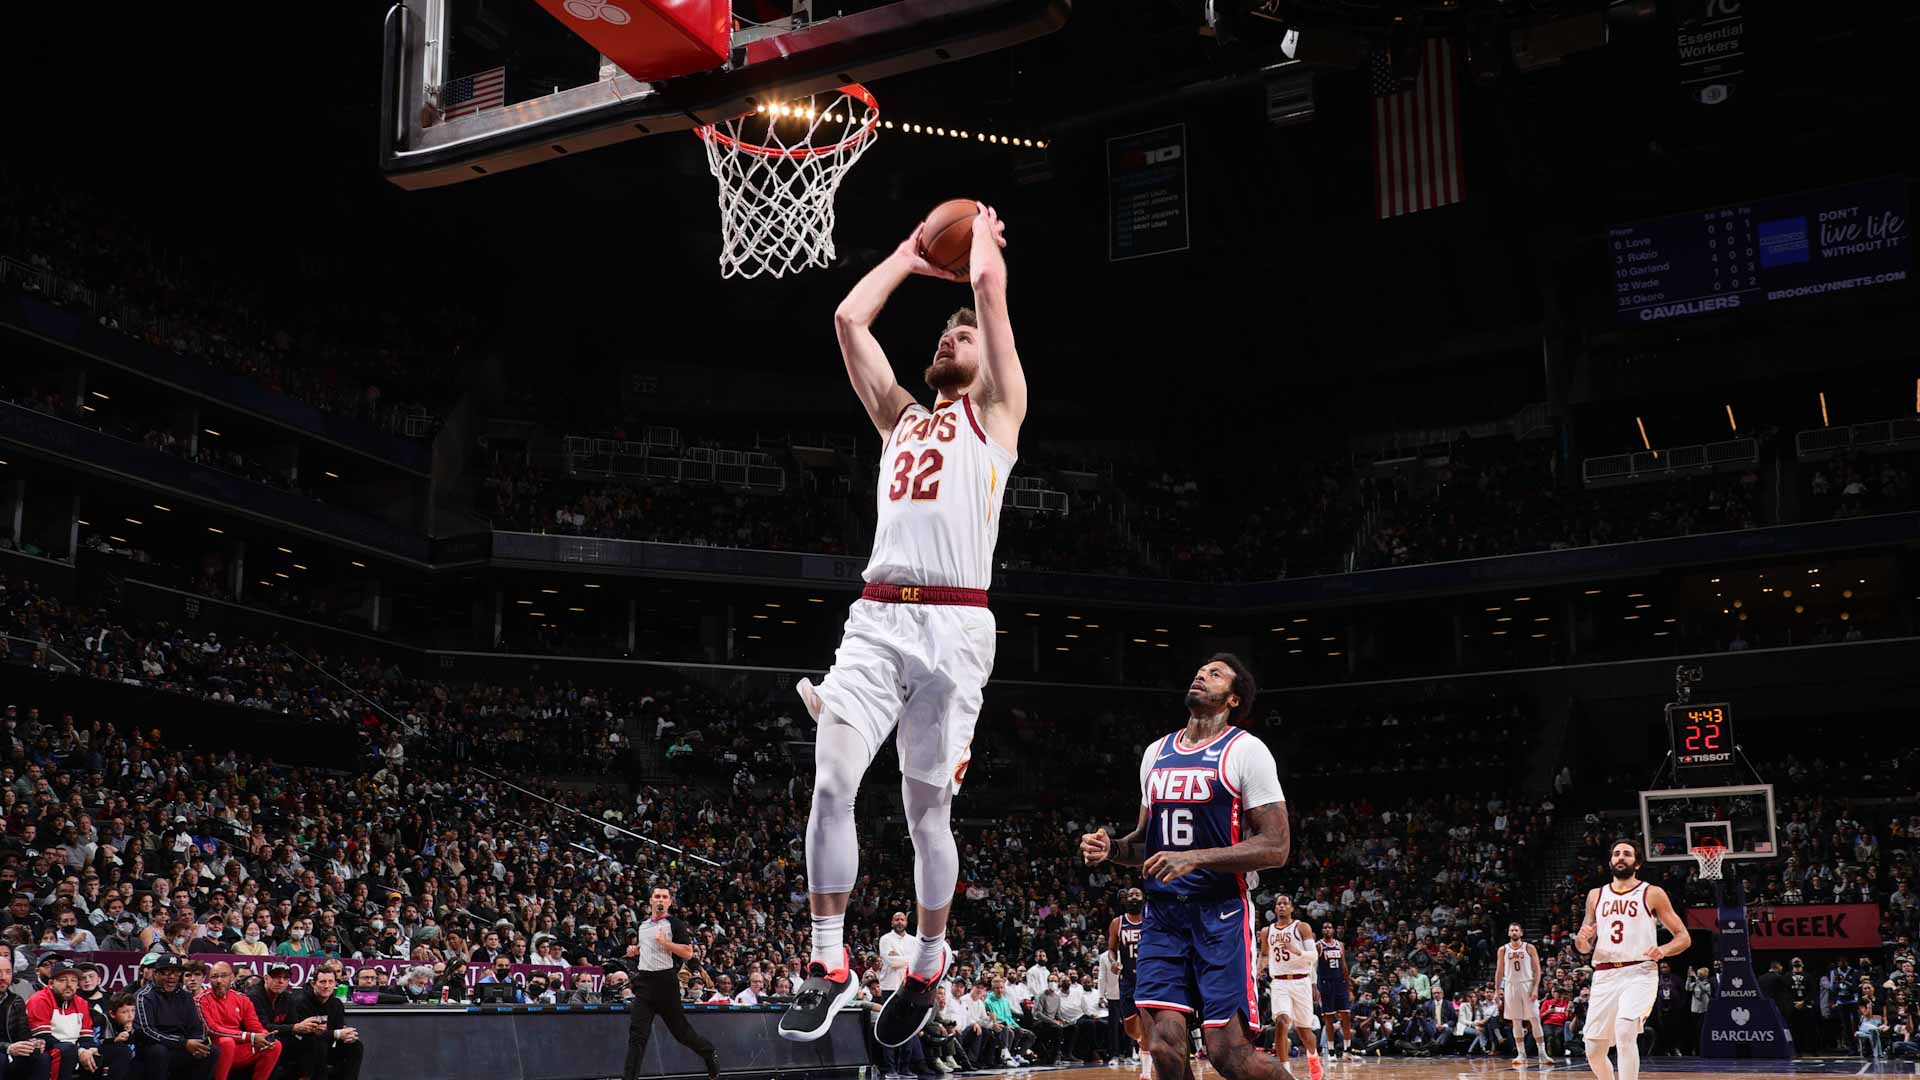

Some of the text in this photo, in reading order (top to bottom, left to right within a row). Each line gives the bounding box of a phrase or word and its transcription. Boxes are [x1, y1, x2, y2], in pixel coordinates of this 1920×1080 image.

[1677, 23, 1744, 47] Essential
[1680, 39, 1739, 59] Workers
[1818, 207, 1860, 222] DON'T
[1820, 223, 1863, 246] live
[1867, 210, 1904, 239] life
[1625, 237, 1652, 248] Love
[1822, 239, 1882, 259] WITHOUT
[1887, 237, 1899, 248] IT
[1627, 250, 1659, 263] Rubio
[1629, 260, 1671, 277] Garland
[1630, 279, 1660, 290] Wade
[1767, 271, 1906, 301] BROOKLYNNETS.COM
[1632, 292, 1664, 304] Okoro
[1640, 295, 1741, 321] CAVALIERS
[888, 448, 944, 501] 32
[901, 587, 920, 601] CLE
[1688, 708, 1723, 723] 4:43
[1685, 724, 1720, 750] 22
[1692, 752, 1732, 763] TISSOT
[1150, 767, 1218, 803] NETS
[1160, 808, 1194, 846] 16
[1601, 900, 1638, 918] CAVS
[1121, 929, 1142, 946] NE
[1270, 931, 1292, 946] CAVS
[1610, 920, 1624, 944] 3
[1273, 946, 1290, 962] 35
[1508, 950, 1525, 960] CAVS
[1328, 959, 1340, 969] 21
[1514, 960, 1521, 972] 0
[1720, 990, 1757, 998] BARCLAYS
[1711, 1029, 1775, 1042] BARCLAYS
